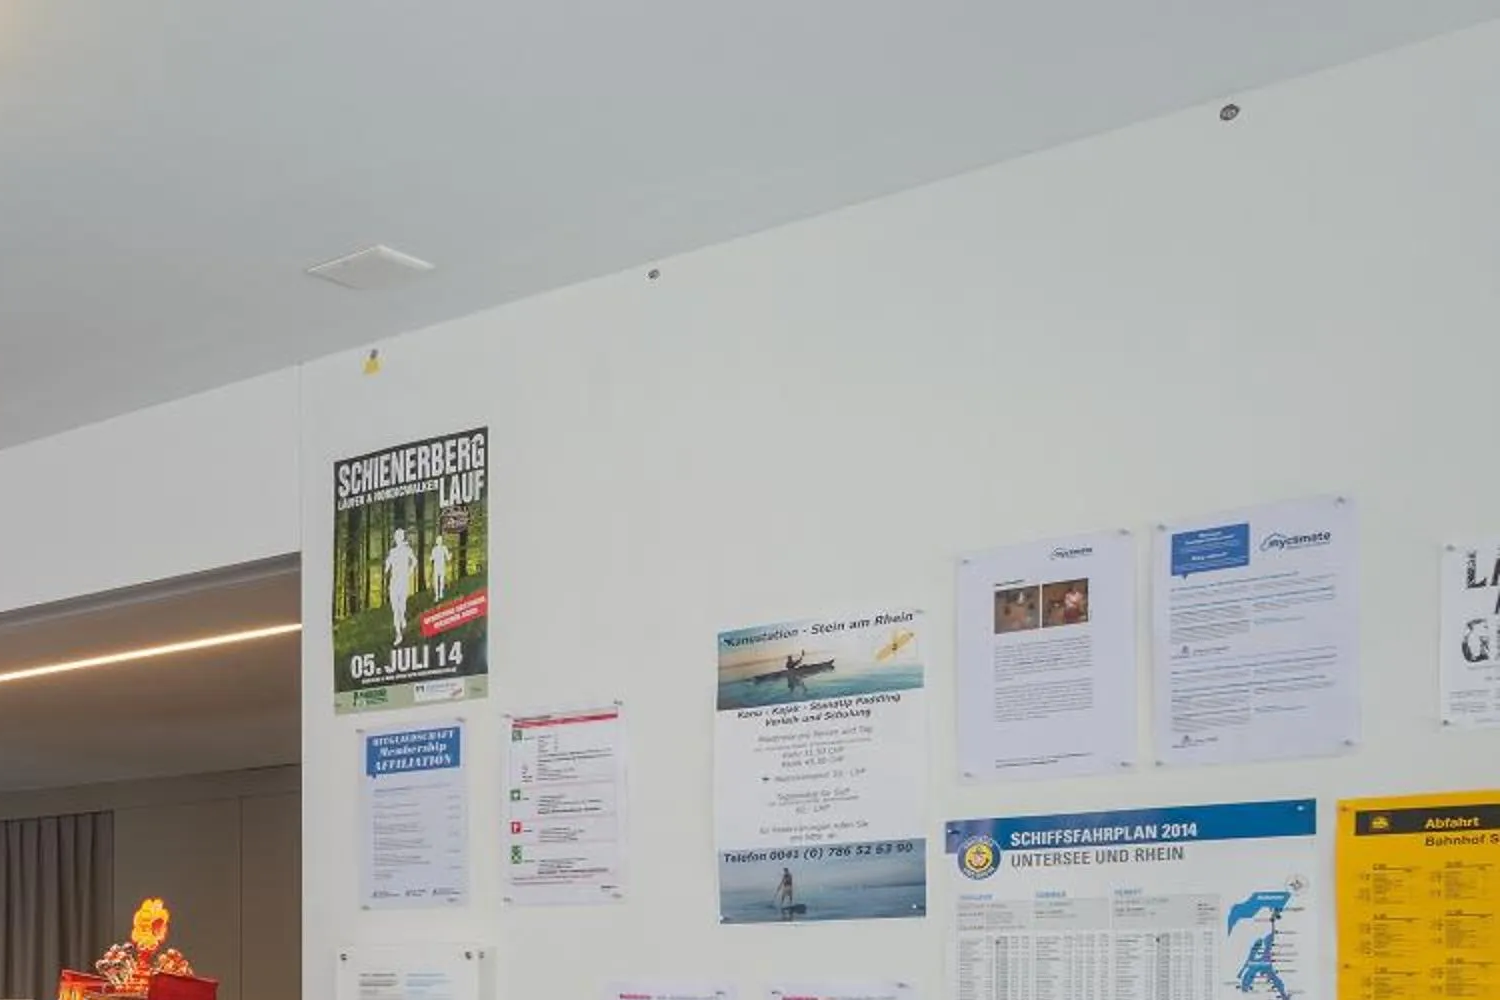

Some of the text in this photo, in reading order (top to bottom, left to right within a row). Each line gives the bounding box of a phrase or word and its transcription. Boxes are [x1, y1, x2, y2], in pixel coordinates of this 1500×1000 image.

[338, 433, 485, 498] SCHIENERBERG
[439, 470, 485, 508] LAUF
[810, 622, 845, 635] Stein
[849, 619, 870, 630] am
[875, 611, 914, 627] Rhein
[351, 654, 382, 679] 05.
[384, 644, 429, 674] JULI
[435, 641, 463, 667] 14
[1010, 822, 1198, 847] SCHIFFSFAHRPLAN 2014
[1425, 816, 1480, 829] Abfahrt
[1425, 833, 1486, 847] Bahnhof
[1011, 846, 1184, 868] UNTERSEE UND RHEIN
